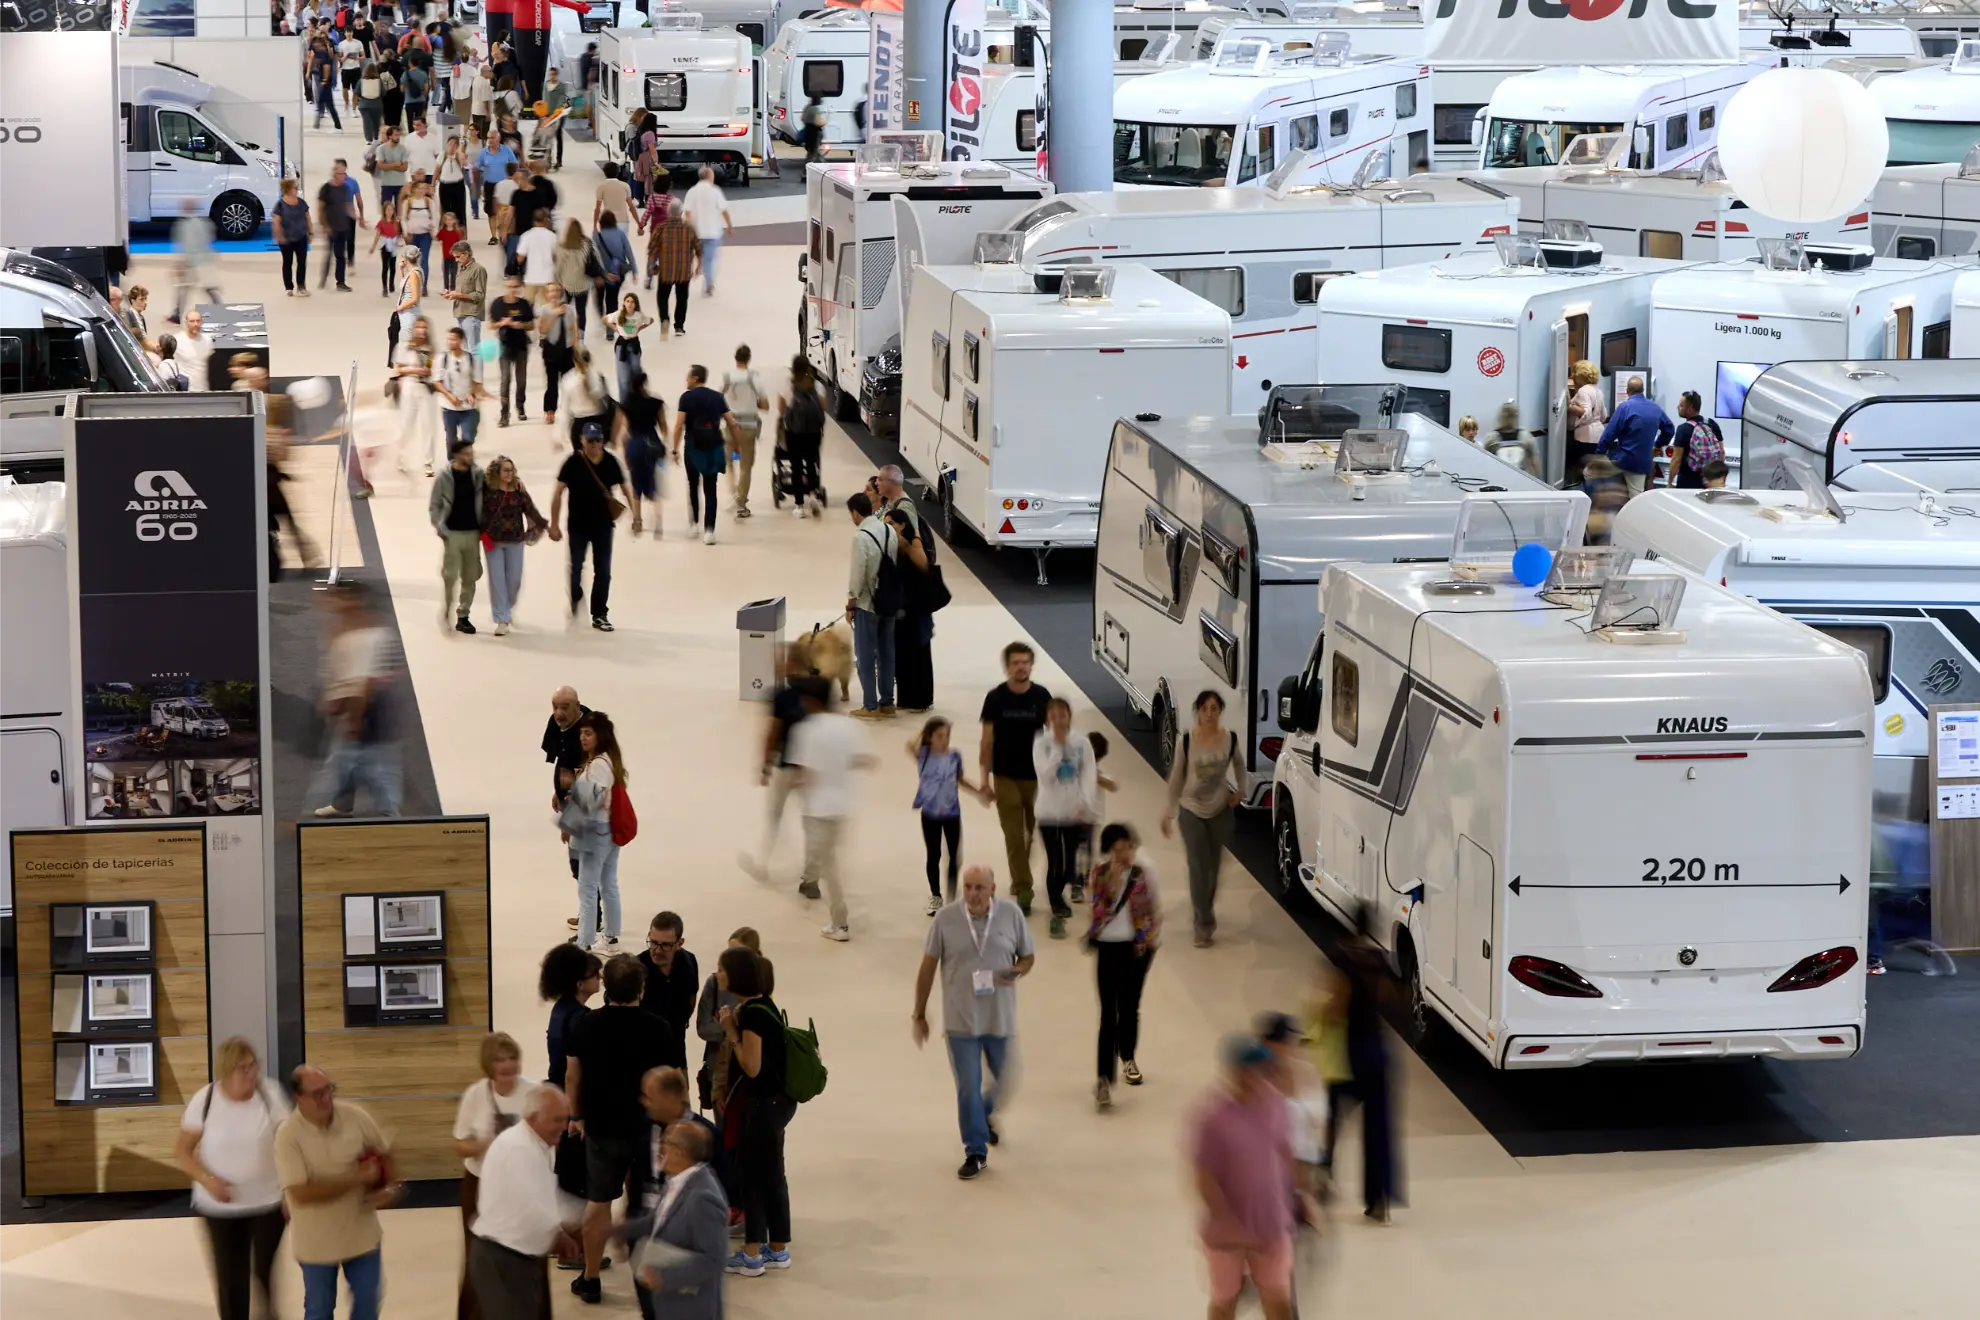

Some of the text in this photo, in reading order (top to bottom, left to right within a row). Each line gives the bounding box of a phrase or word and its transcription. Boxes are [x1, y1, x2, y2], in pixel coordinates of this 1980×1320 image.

[872, 28, 892, 129] FENDT
[1715, 322, 1782, 339] Ligera 1.000 kg
[125, 499, 208, 511] ADRIA
[136, 513, 198, 542] 60
[1656, 716, 1728, 734] KNAUS
[92, 859, 109, 869] de
[1641, 857, 1739, 886] 2,20 m
